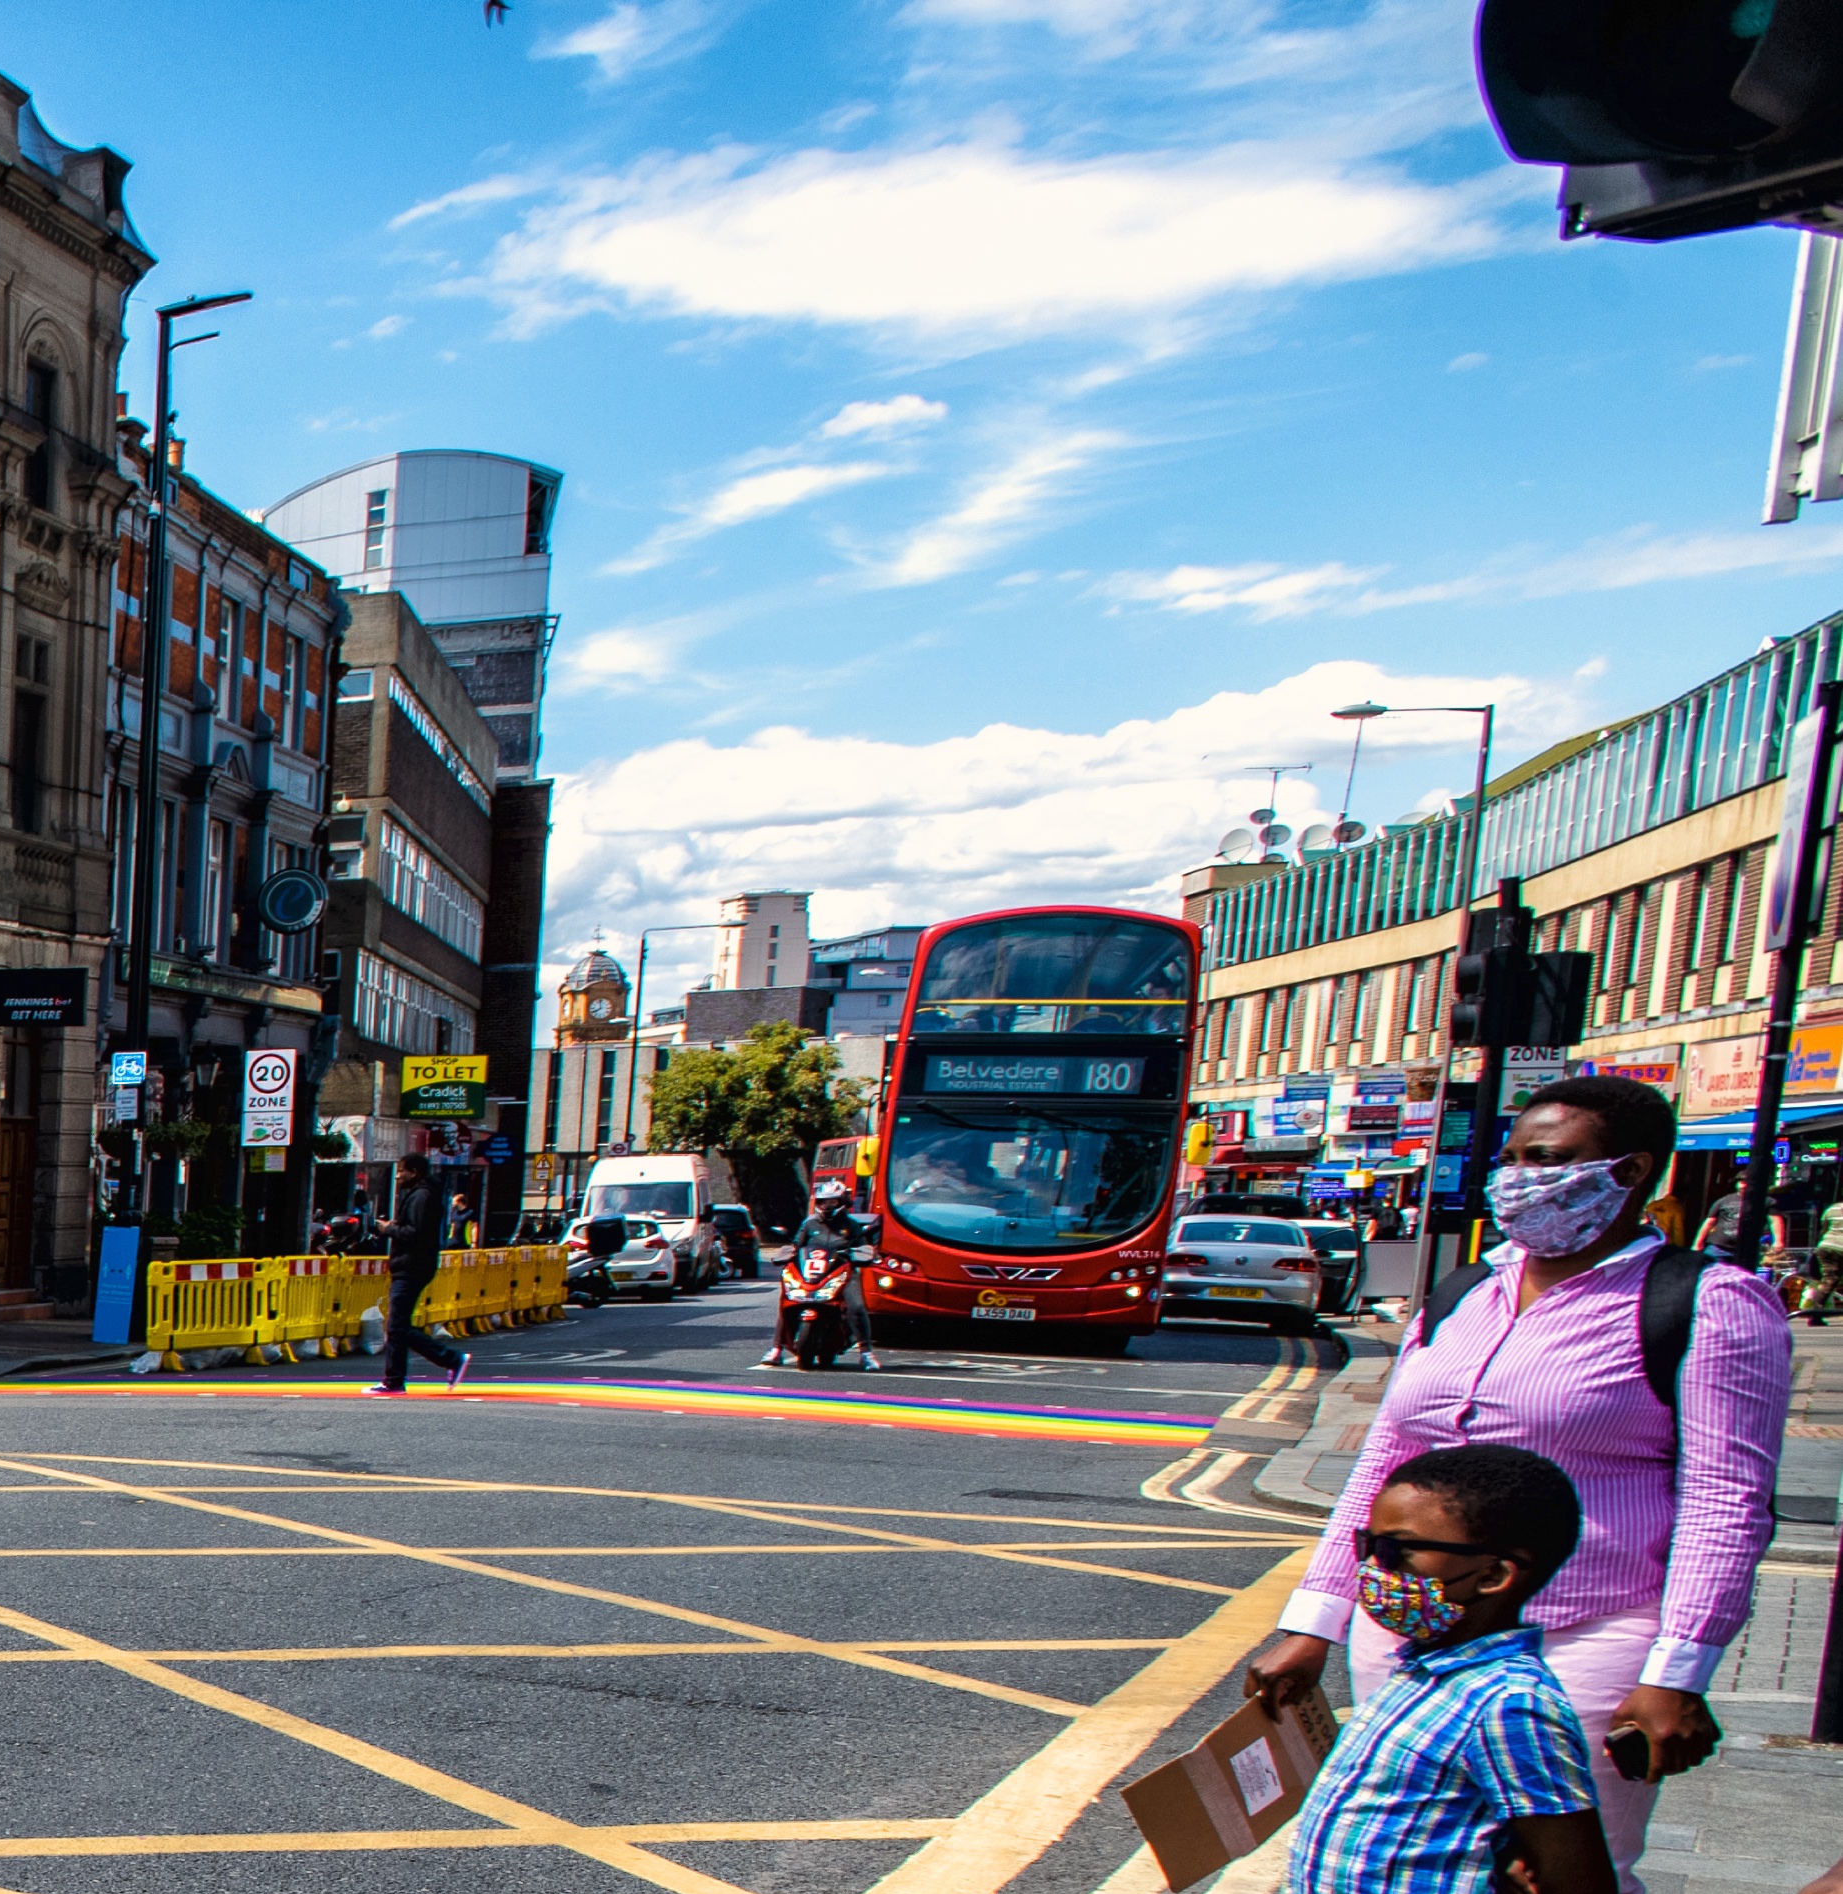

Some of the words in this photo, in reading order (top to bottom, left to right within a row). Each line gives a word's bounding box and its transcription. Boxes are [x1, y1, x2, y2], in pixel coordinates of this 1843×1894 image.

[4, 998, 54, 1007] JENNINGS
[10, 1010, 32, 1020] BET
[32, 1010, 63, 1020] HERE
[1509, 1046, 1560, 1062] ZONE
[431, 1057, 459, 1066] SHOP
[256, 1065, 285, 1082] 20
[410, 1066, 437, 1079] TO
[443, 1066, 478, 1079] LET
[938, 1060, 1060, 1079] Belvedere
[1085, 1063, 1131, 1091] 180
[1606, 1065, 1669, 1082] Tasty
[418, 1085, 467, 1098] Cradick
[946, 1081, 1005, 1090] INDUSTRIAL
[1008, 1081, 1047, 1090] ESTATE
[249, 1096, 287, 1108] ZONE
[1118, 1250, 1161, 1259] WVL316
